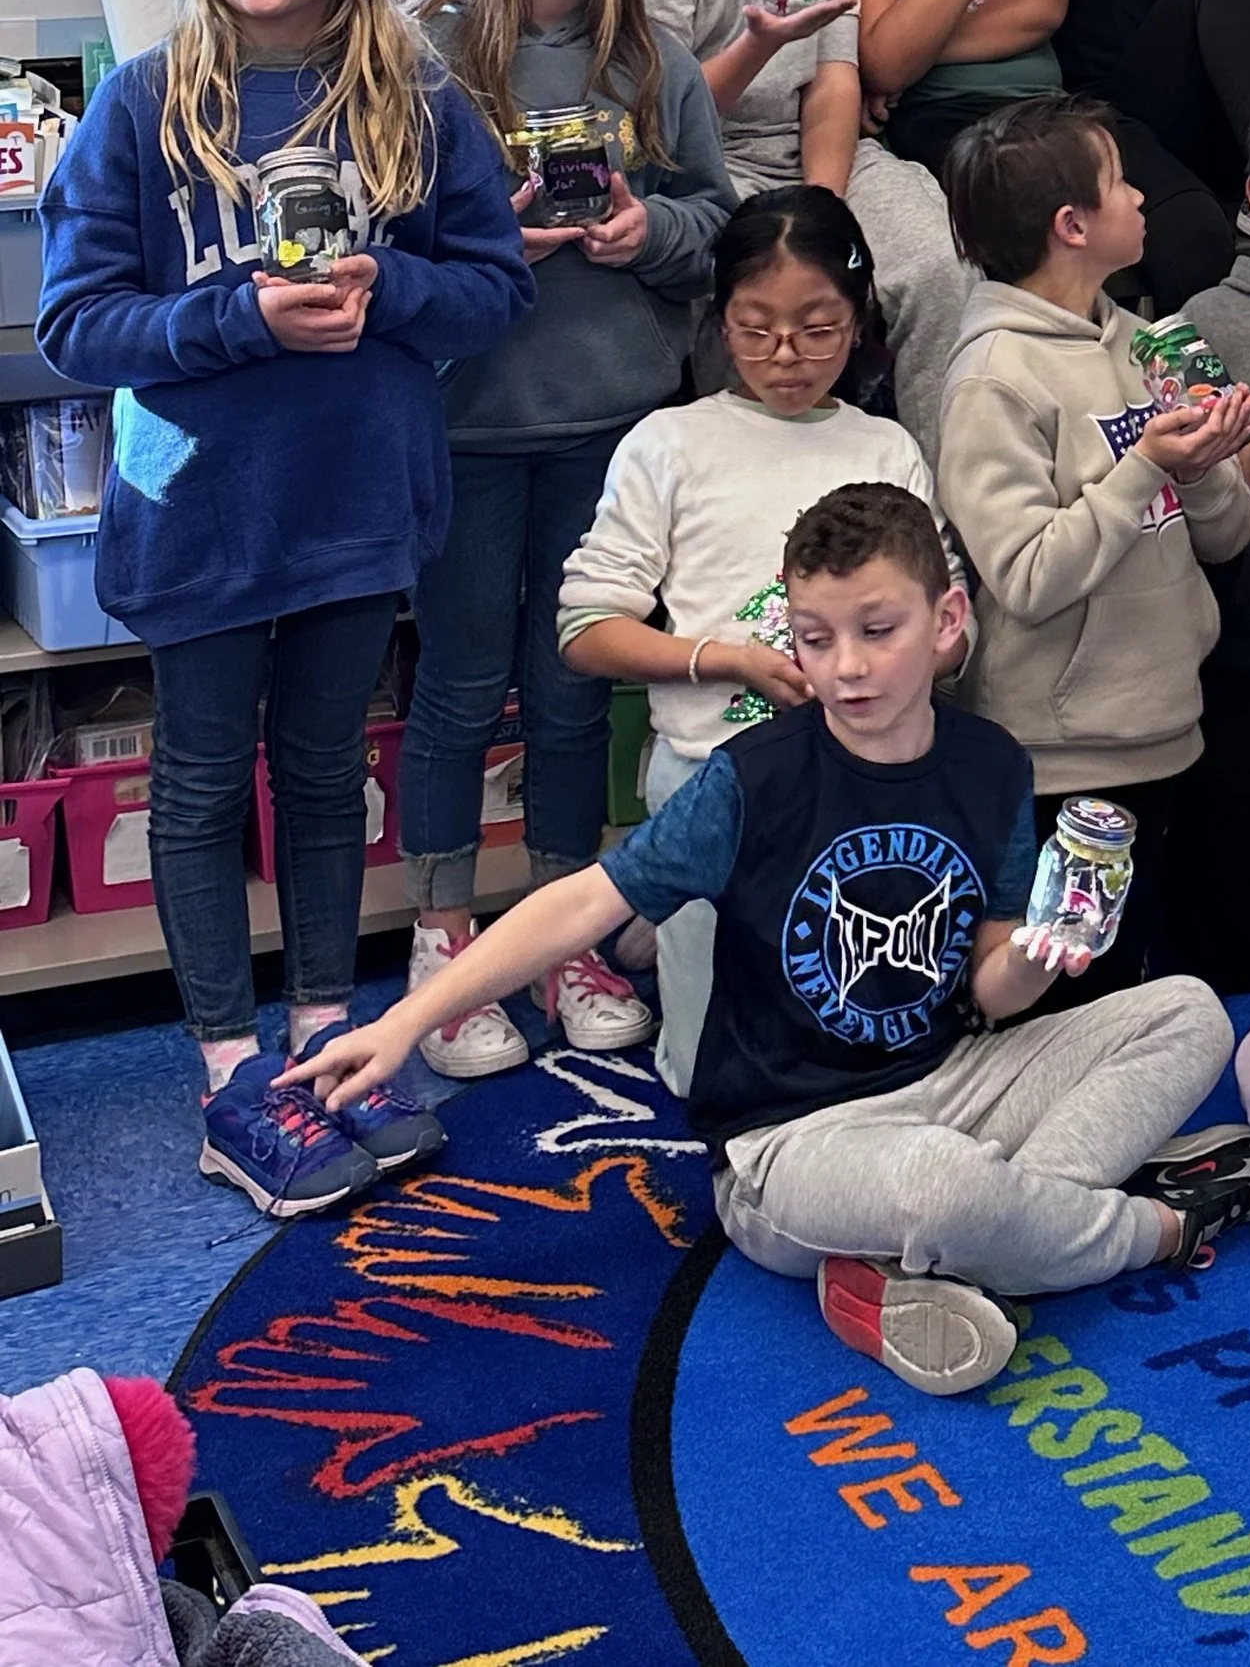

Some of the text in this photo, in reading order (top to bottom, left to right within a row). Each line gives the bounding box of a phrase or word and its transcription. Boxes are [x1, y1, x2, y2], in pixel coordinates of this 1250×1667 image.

[802, 829, 979, 913] LEGENDARY
[790, 949, 876, 1043] NEVER
[783, 1386, 963, 1530] WE
